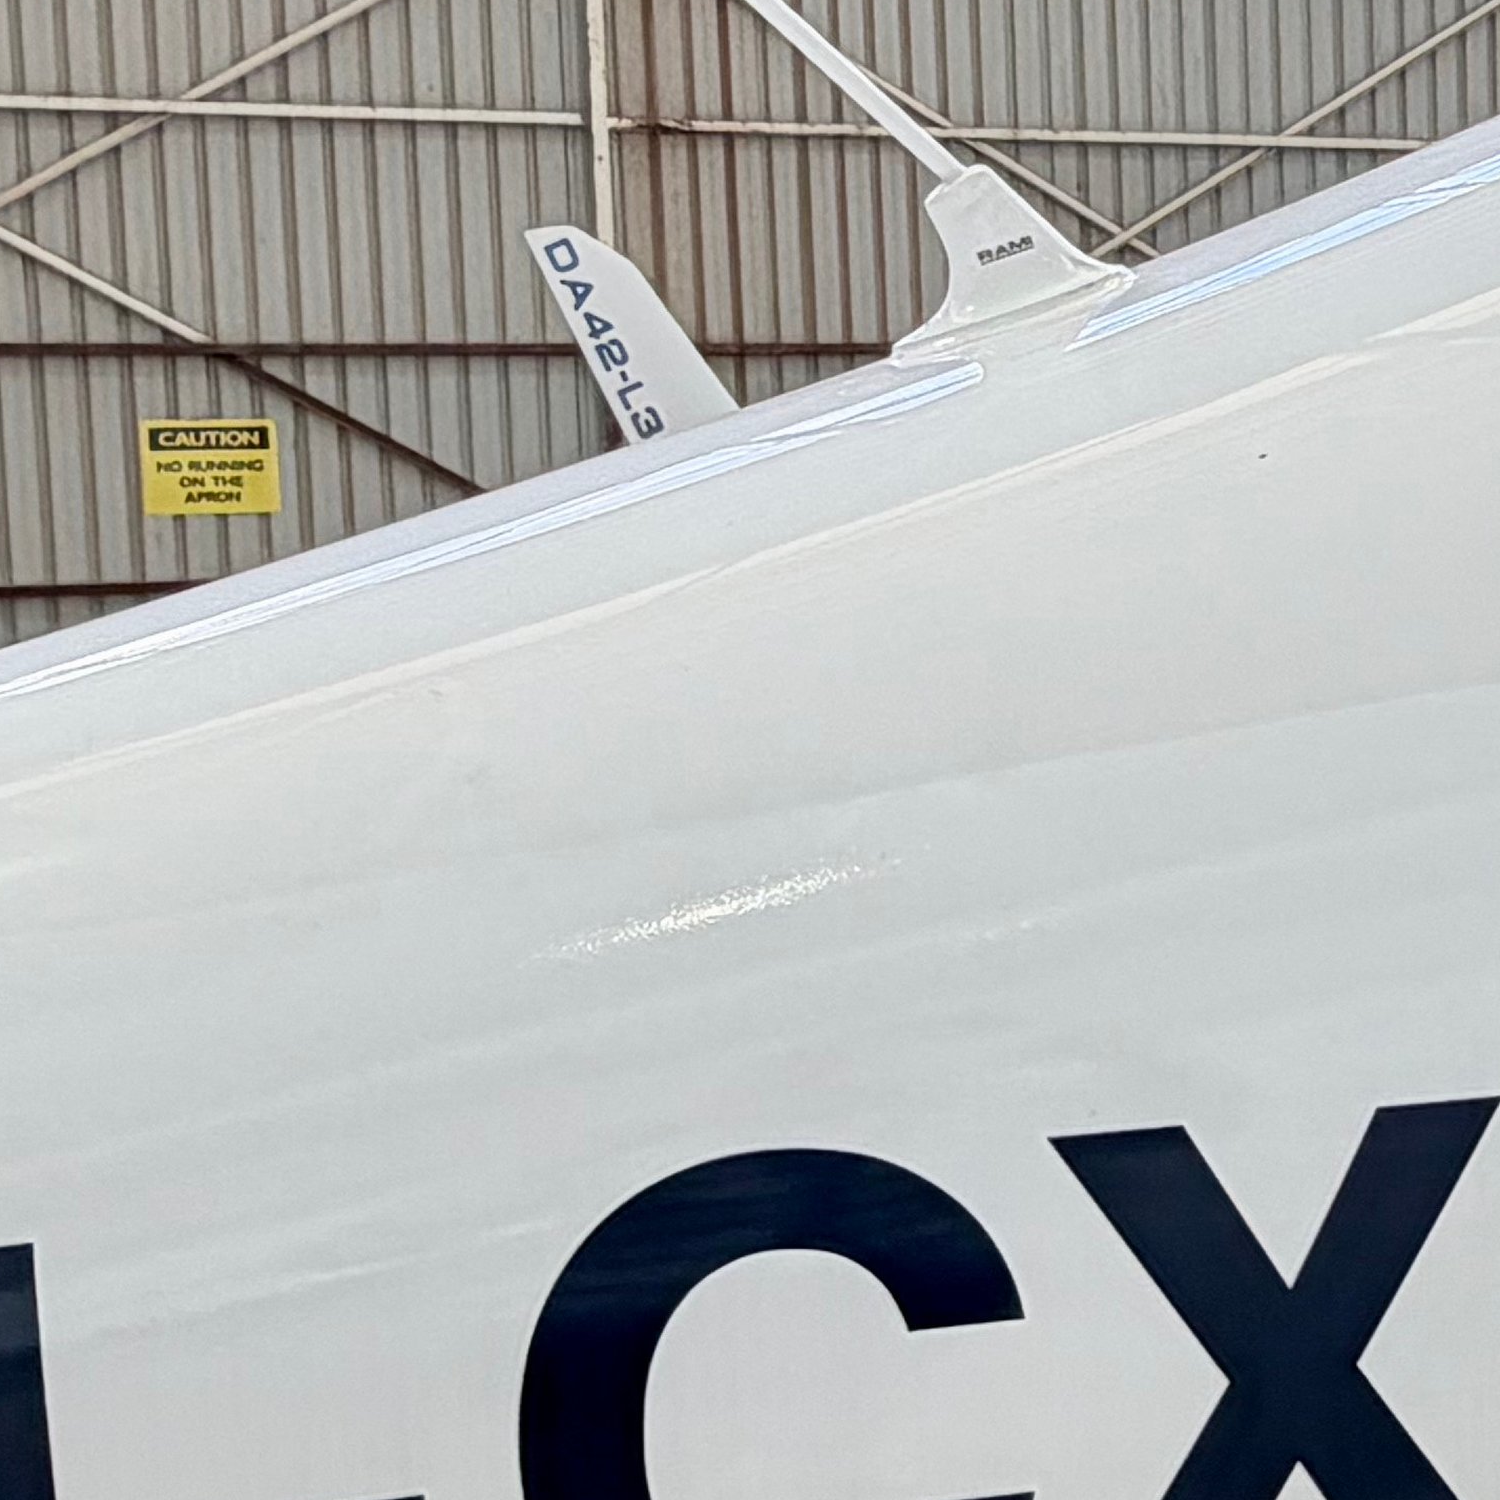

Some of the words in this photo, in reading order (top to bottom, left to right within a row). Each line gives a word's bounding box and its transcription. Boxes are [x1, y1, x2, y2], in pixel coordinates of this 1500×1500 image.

[543, 237, 665, 440] DA42-L3
[157, 429, 261, 448] CAUTION
[156, 460, 183, 473] NO
[187, 458, 265, 473] RUNNING
[179, 475, 206, 489] ON
[211, 475, 244, 488] THE
[183, 490, 243, 504] APRON
